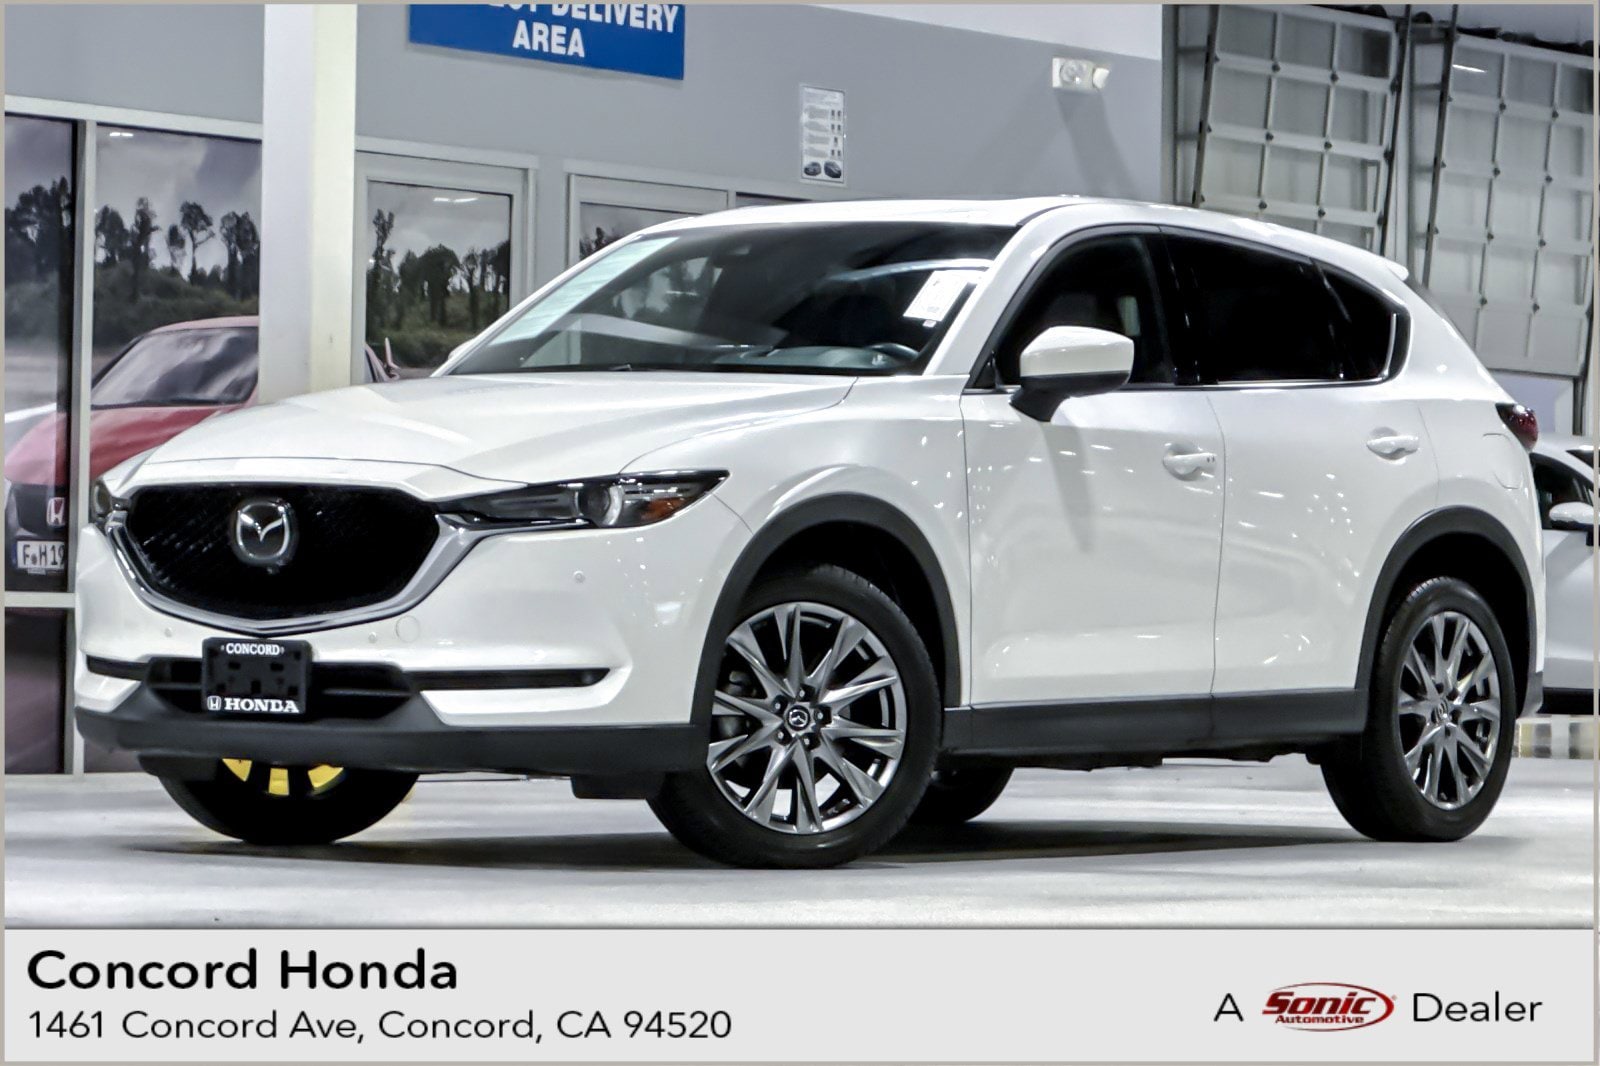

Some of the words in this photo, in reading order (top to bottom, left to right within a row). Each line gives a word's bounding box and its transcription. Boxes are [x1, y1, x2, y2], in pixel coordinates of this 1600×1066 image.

[512, 20, 585, 58] AREA
[226, 643, 280, 656] CONCORD
[224, 698, 300, 713] HONDA
